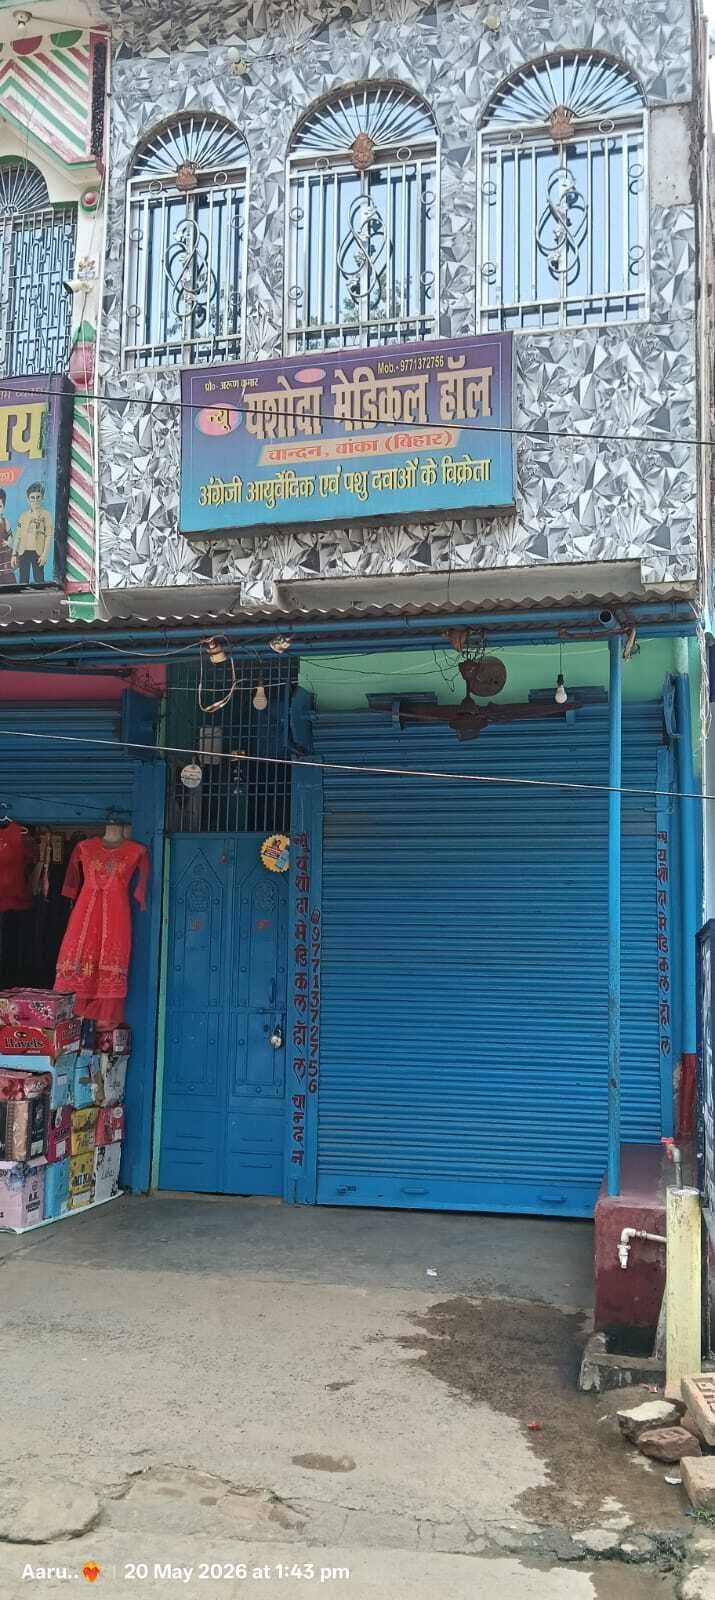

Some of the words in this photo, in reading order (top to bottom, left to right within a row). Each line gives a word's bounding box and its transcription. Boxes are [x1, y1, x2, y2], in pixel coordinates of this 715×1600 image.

[331, 366, 430, 431] मेडिकल
[437, 355, 493, 420] हॉल
[199, 475, 243, 508] अंग्रेजी
[319, 464, 343, 497] एवं
[344, 471, 369, 501] पशु
[420, 457, 438, 487] के
[441, 453, 492, 487] विक्रेता
